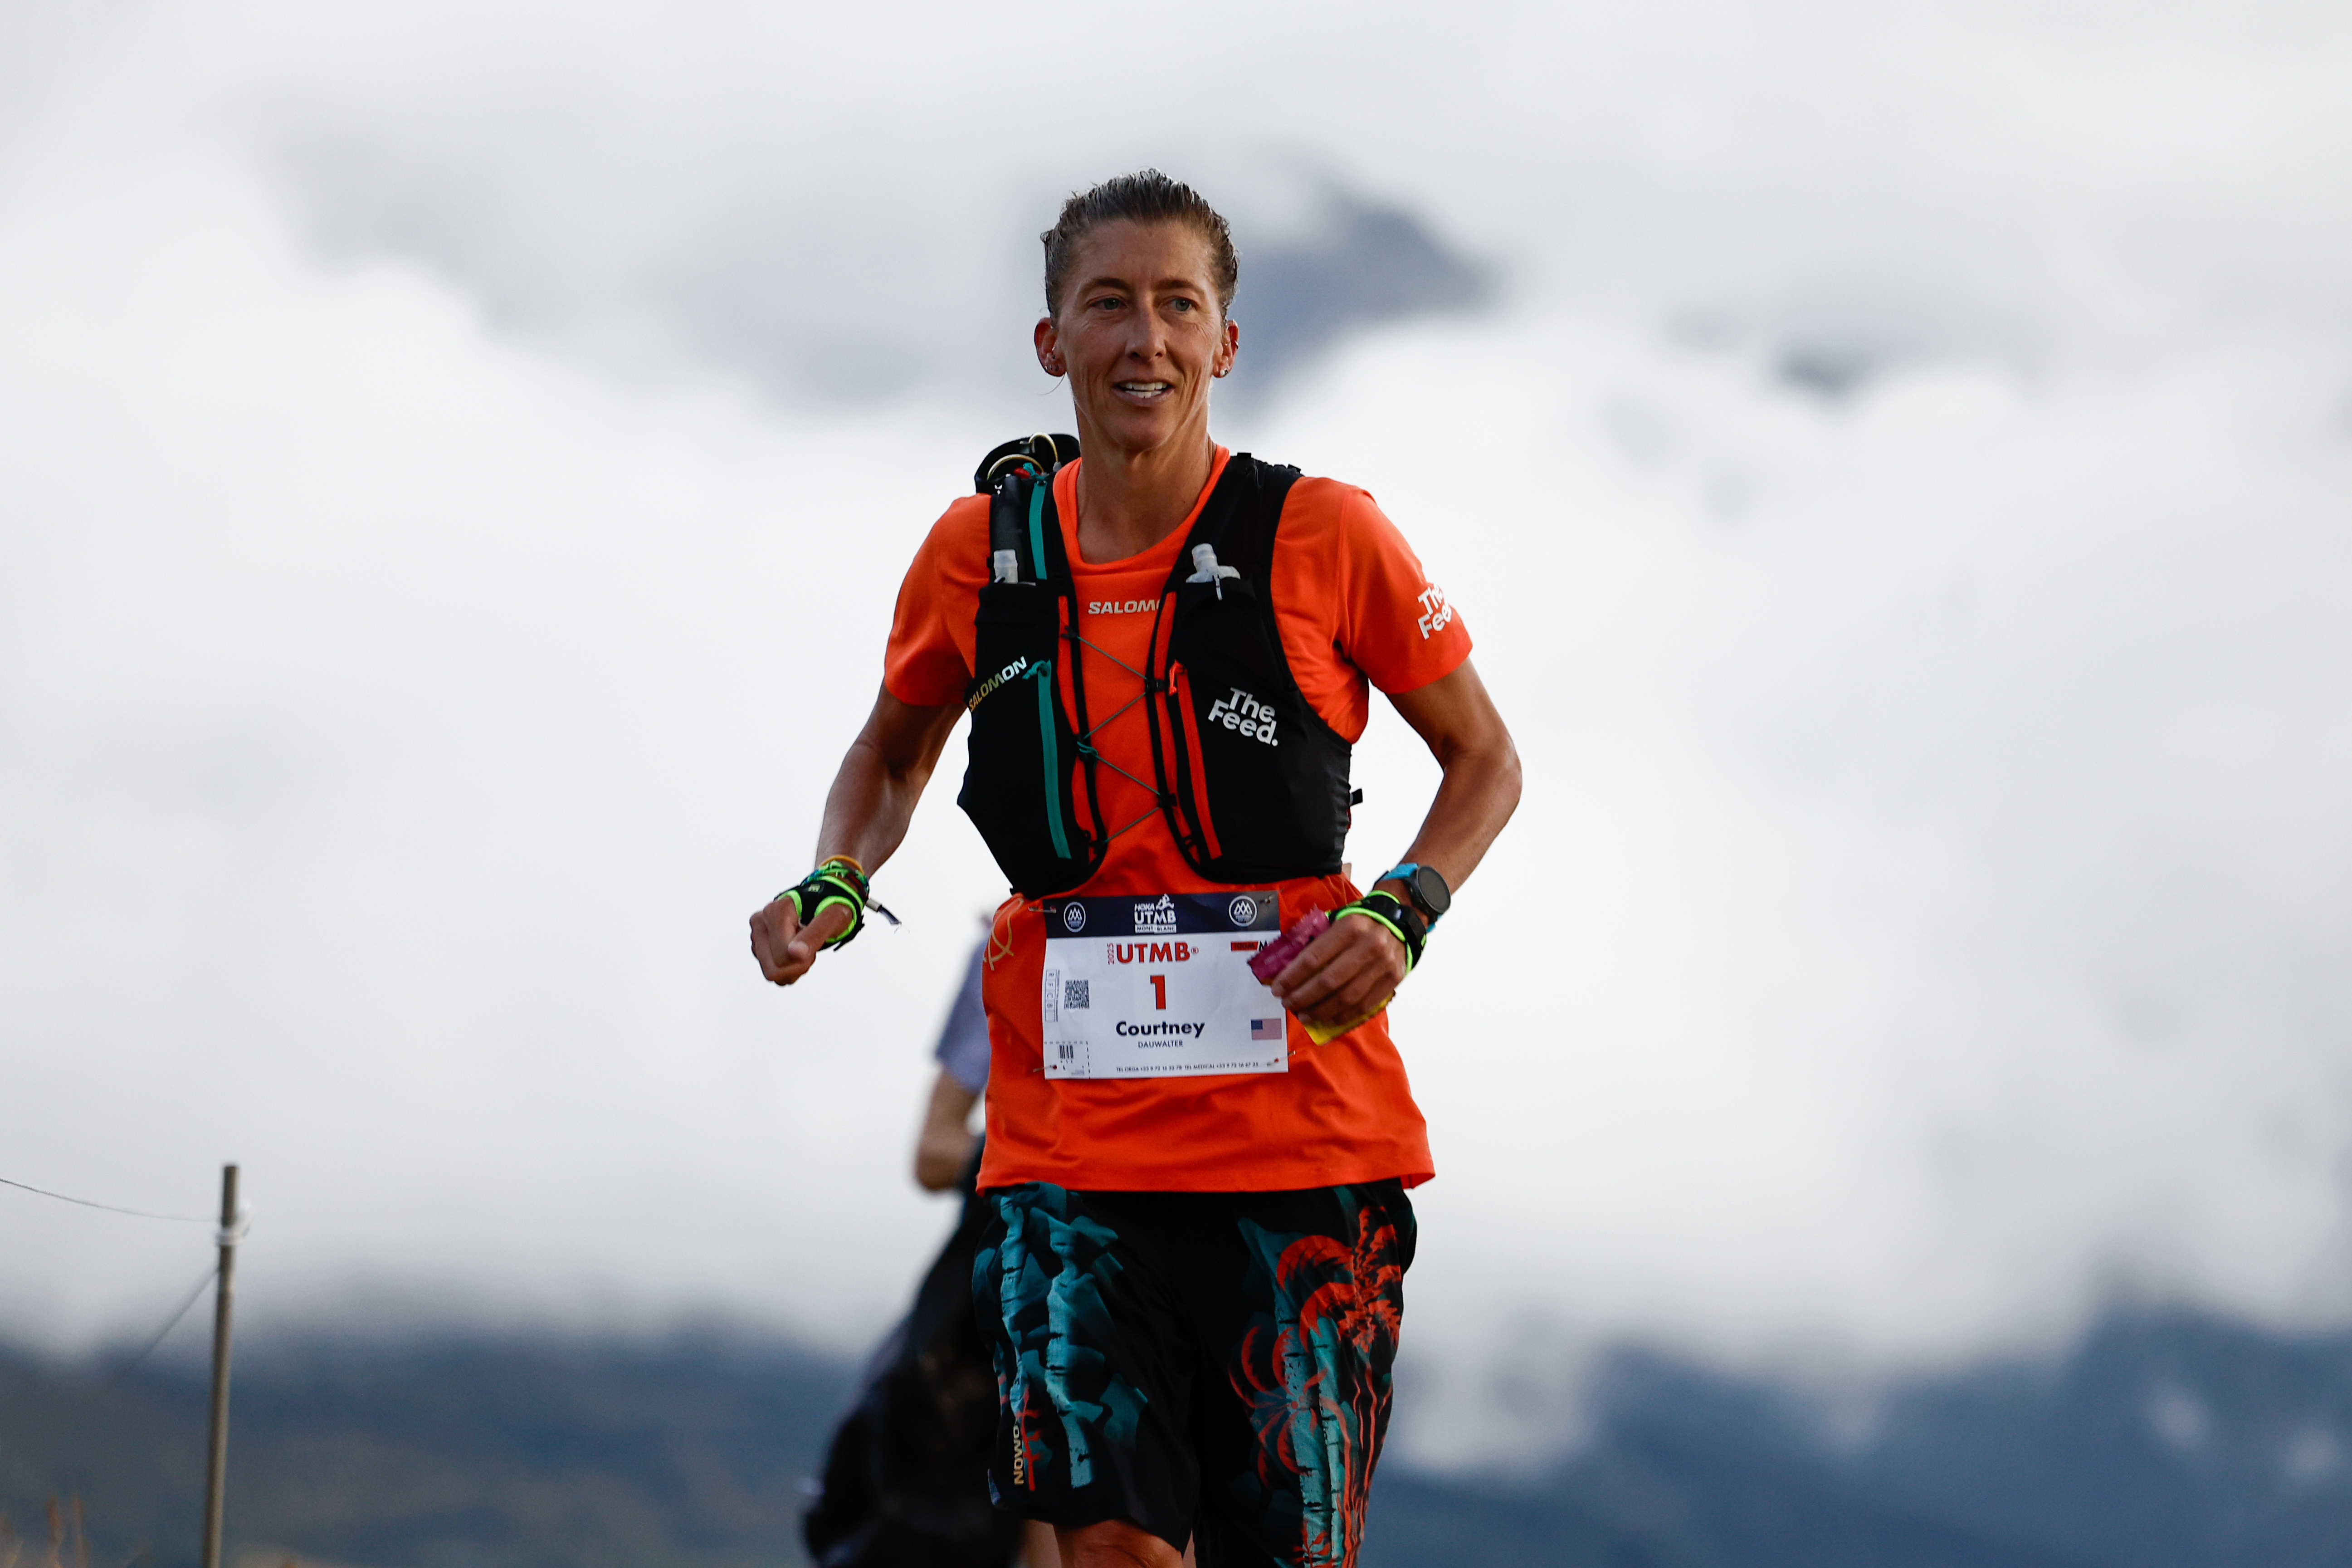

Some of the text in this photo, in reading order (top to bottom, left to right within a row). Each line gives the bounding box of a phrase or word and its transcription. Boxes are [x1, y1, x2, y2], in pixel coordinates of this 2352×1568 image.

[1088, 599, 1160, 614] SALOM
[1417, 583, 1443, 615] The
[969, 655, 1027, 713] SALOMON
[1230, 687, 1275, 723] The
[1208, 699, 1278, 747] Feed.
[1134, 910, 1176, 924] UTMB
[1150, 975, 1166, 1010] 1
[1116, 1021, 1205, 1039] Courtney
[1138, 1040, 1183, 1048] DAUWALTER
